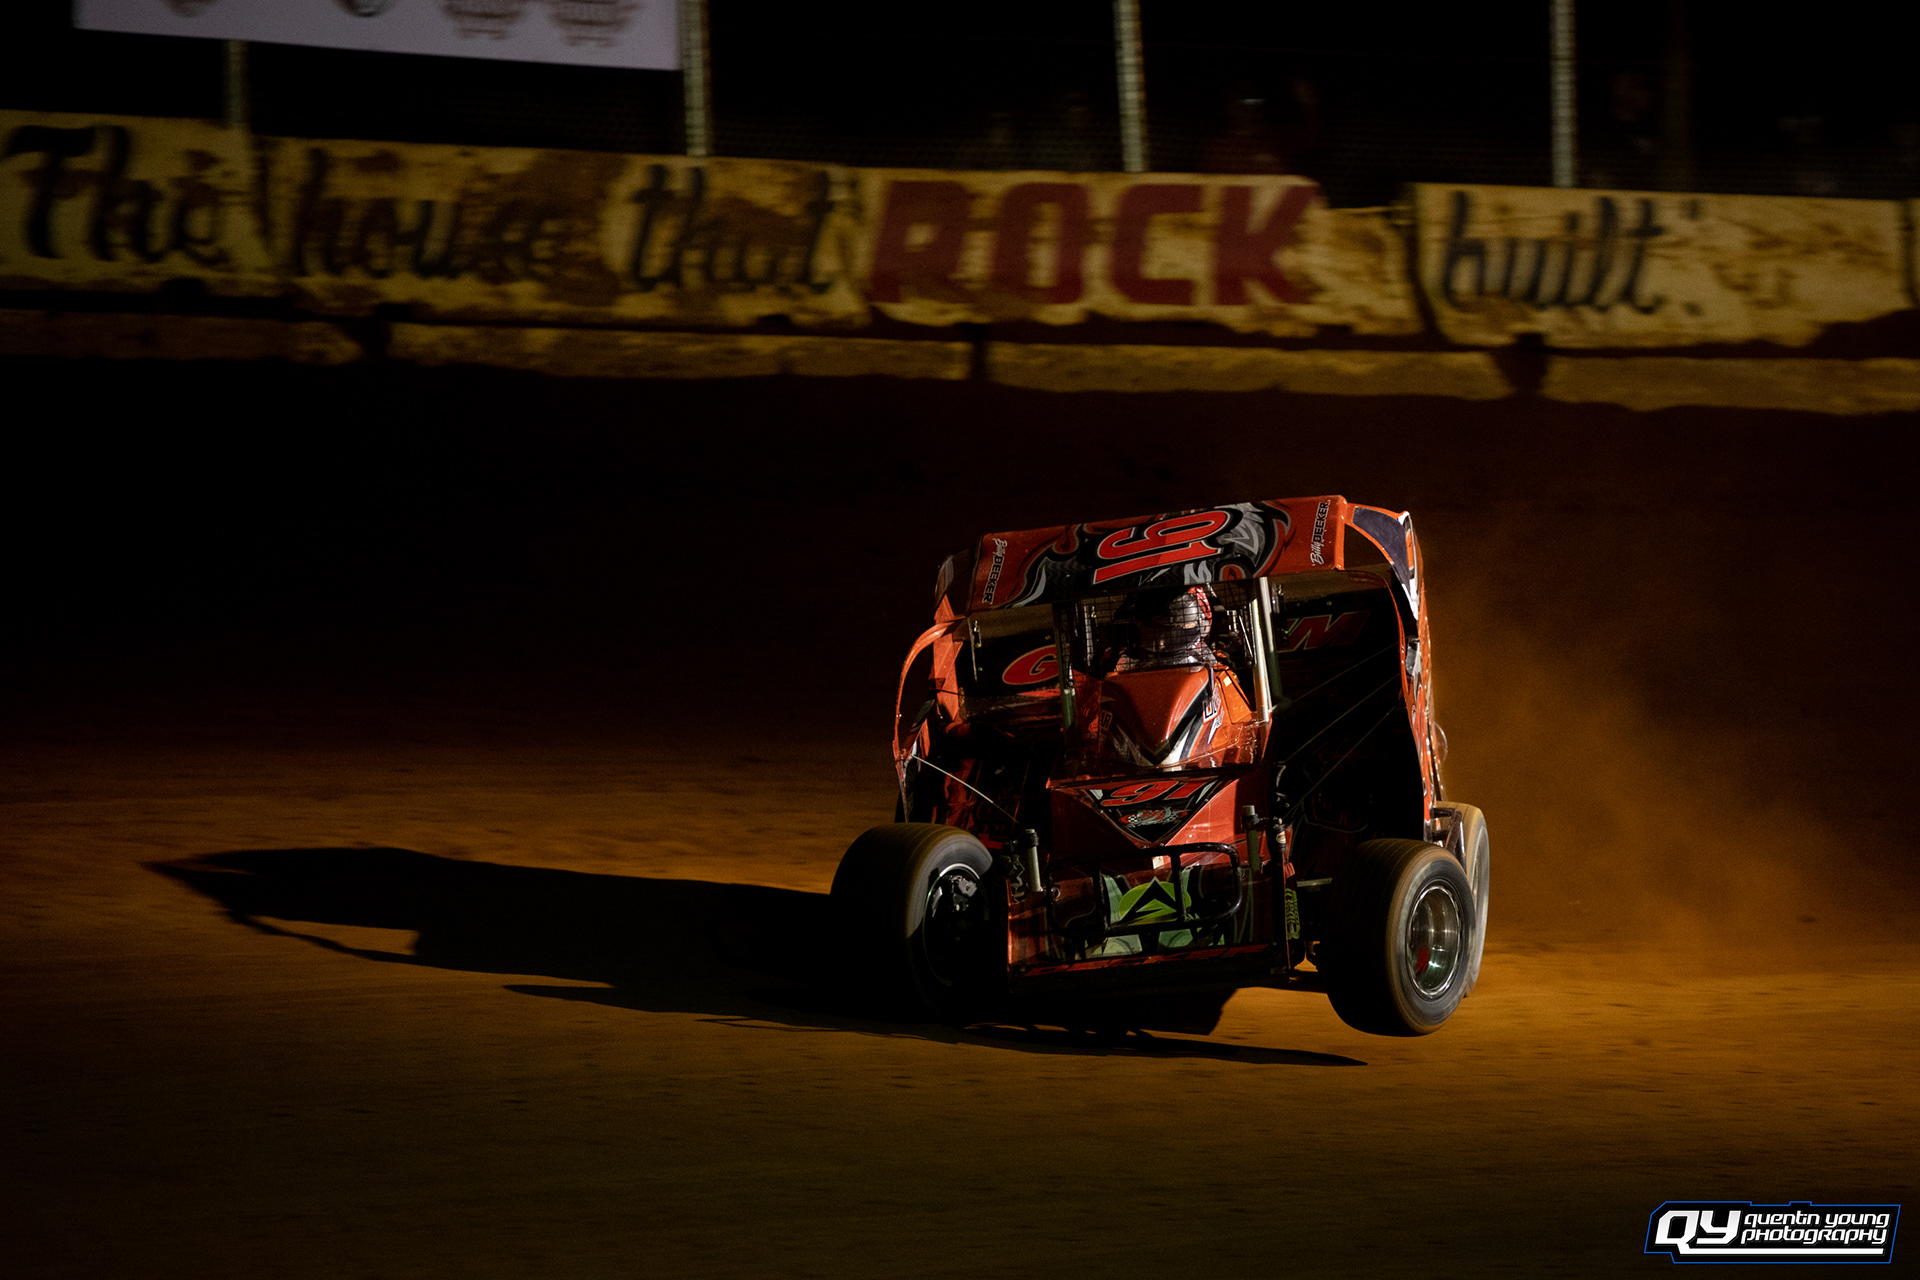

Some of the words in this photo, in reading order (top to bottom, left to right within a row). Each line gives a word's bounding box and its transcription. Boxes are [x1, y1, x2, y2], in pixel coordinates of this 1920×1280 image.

[2, 124, 231, 266] The
[290, 148, 556, 286] house
[630, 164, 838, 292] that
[866, 180, 1322, 306] ROCK
[1311, 501, 1331, 543] DECKER
[1309, 541, 1325, 566] Billy
[982, 555, 1005, 605] DECKER
[1100, 773, 1219, 807] 91
